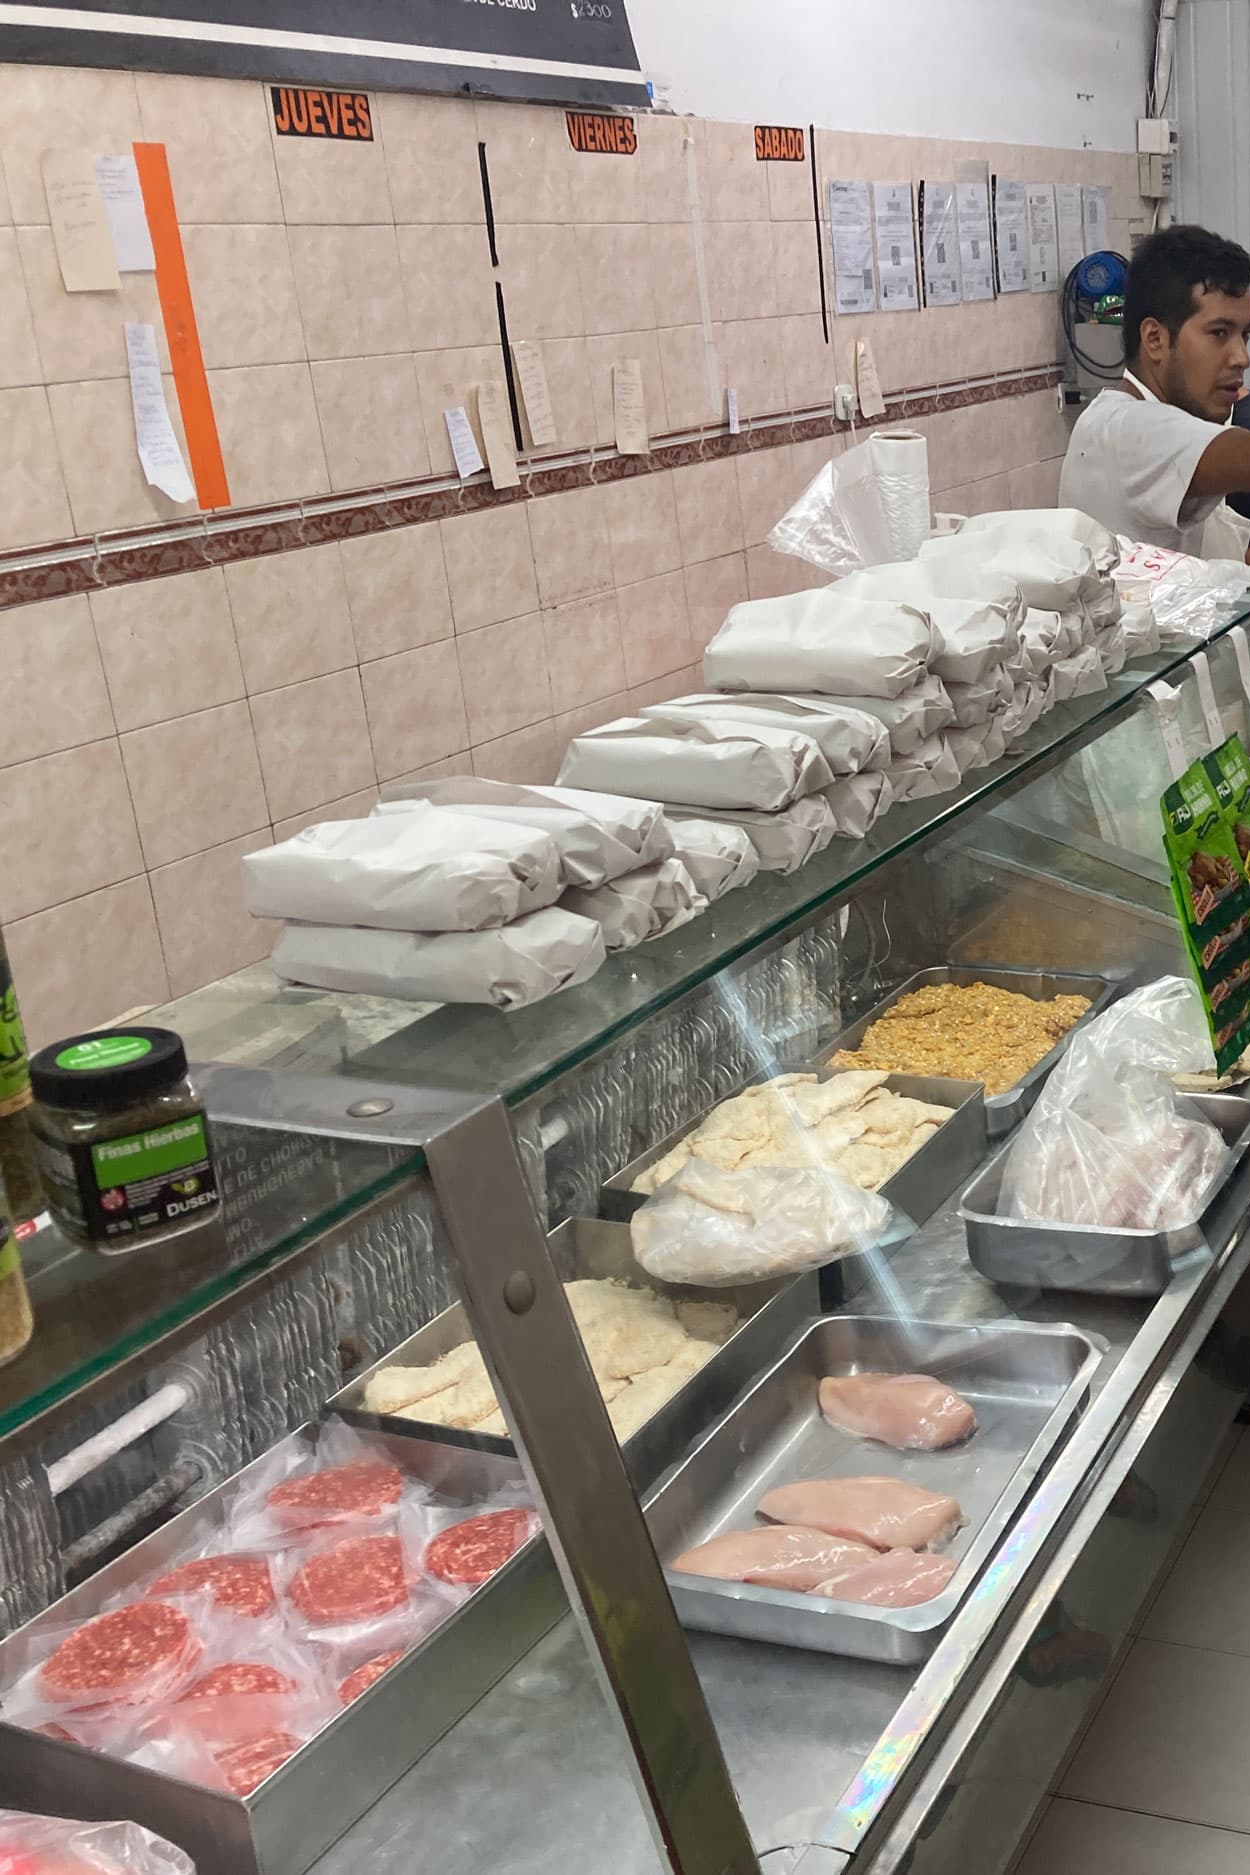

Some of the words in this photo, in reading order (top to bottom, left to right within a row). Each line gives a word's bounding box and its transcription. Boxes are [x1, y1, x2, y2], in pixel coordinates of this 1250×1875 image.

[275, 88, 371, 138] JUEVES
[566, 112, 637, 152] VIERNES
[755, 125, 805, 161] SABADO
[166, 1189, 218, 1218] DUSEN
